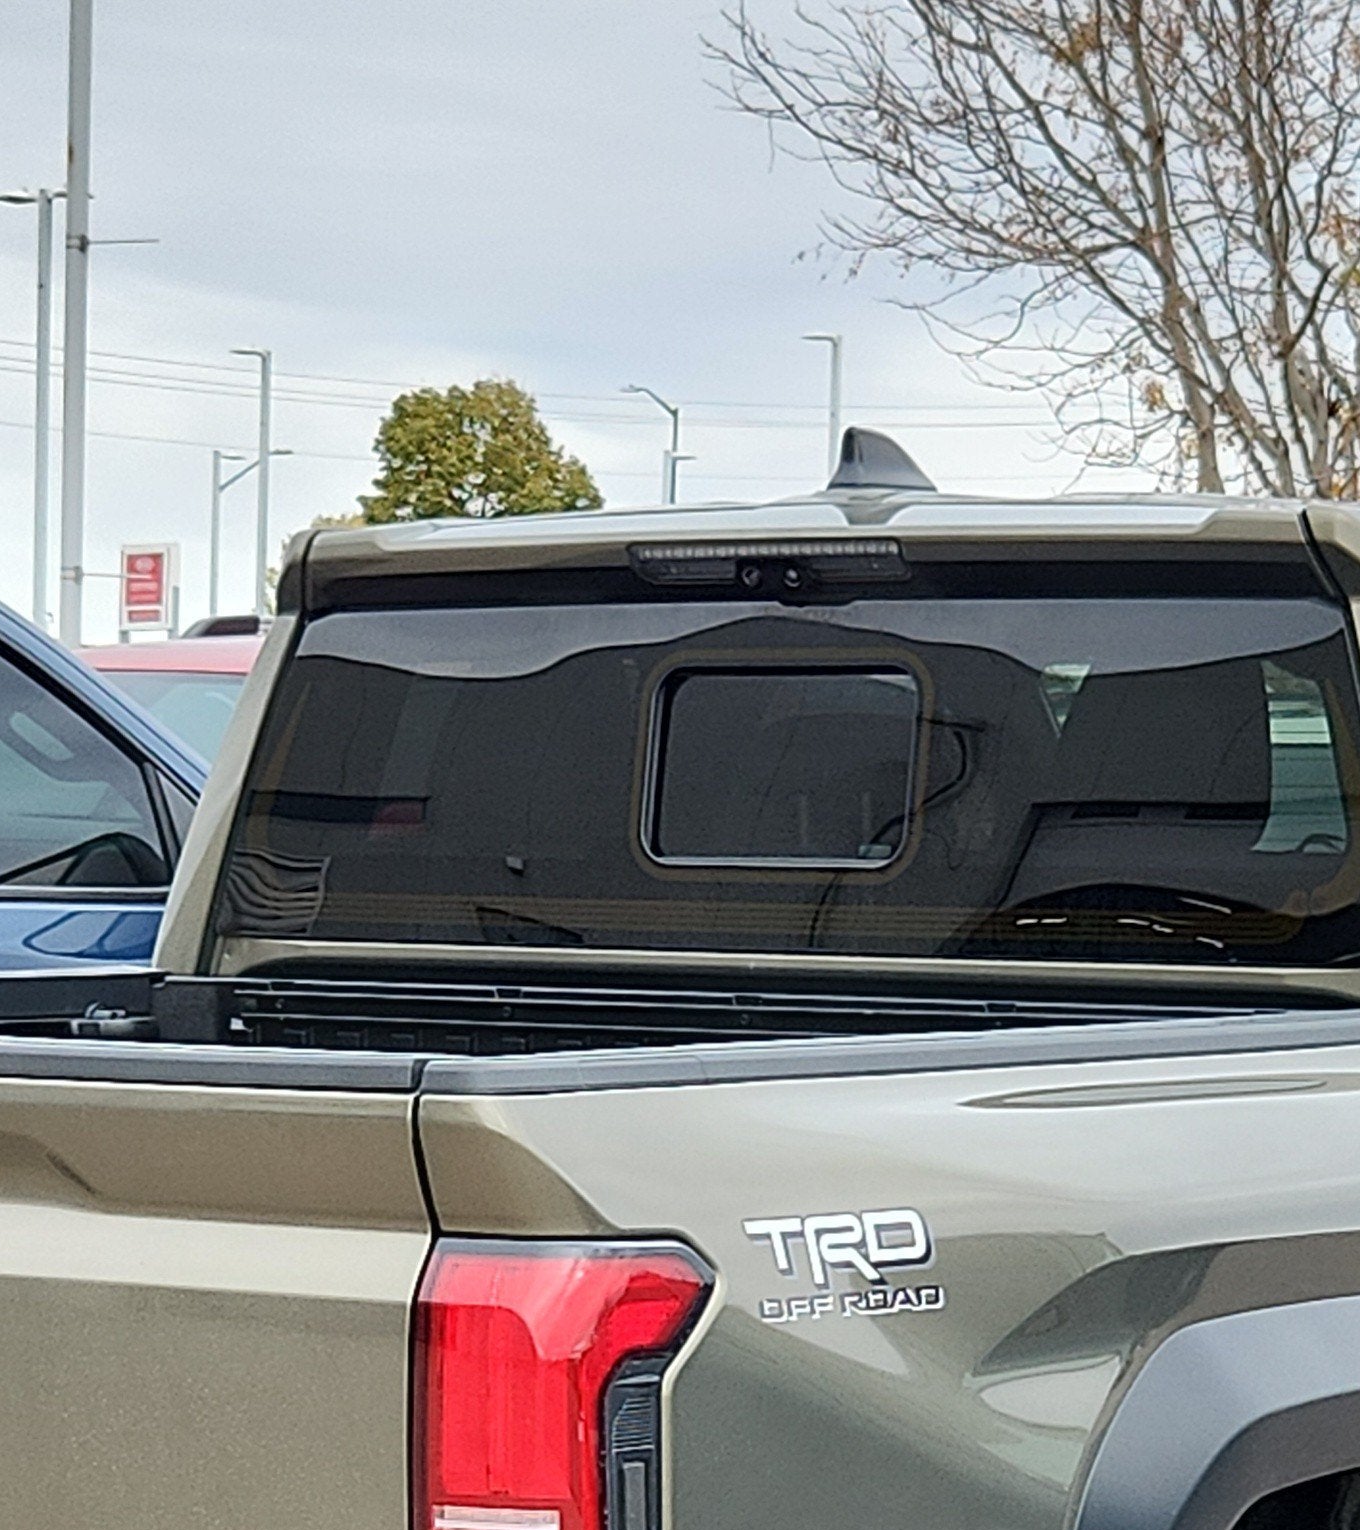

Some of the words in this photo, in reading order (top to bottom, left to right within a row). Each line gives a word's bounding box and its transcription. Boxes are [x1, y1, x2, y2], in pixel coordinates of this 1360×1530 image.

[740, 1206, 932, 1289] TRD
[759, 1295, 834, 1324] OFF
[838, 1284, 946, 1319] ROAD
